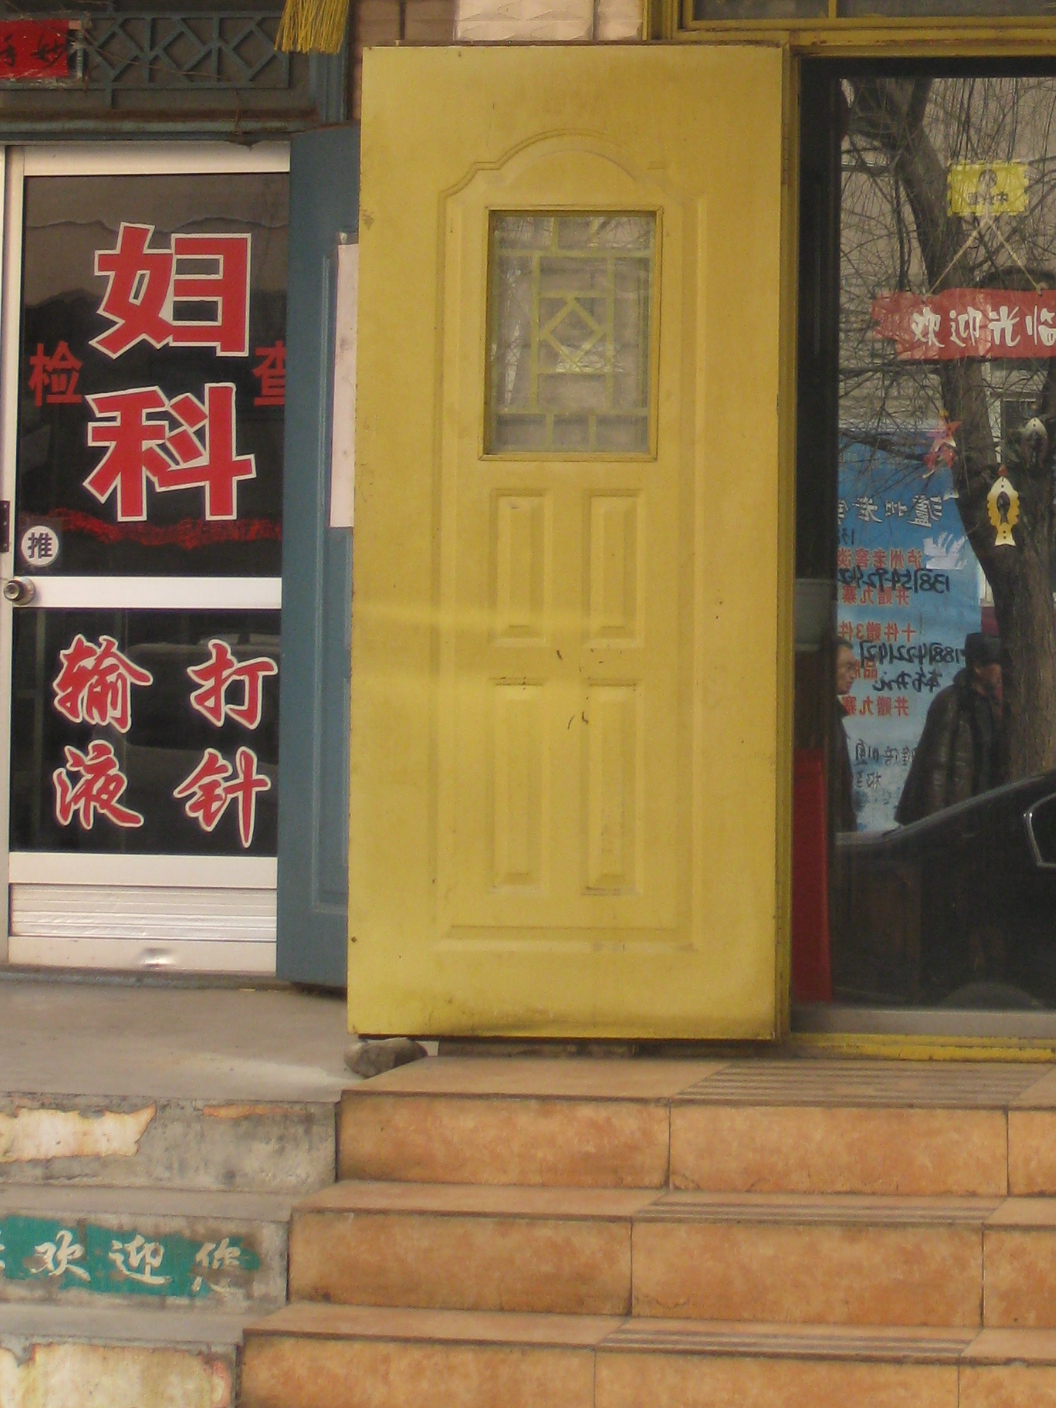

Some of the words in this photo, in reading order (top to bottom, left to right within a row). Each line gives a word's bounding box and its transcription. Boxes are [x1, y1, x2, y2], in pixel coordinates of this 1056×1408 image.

[83, 222, 257, 522] 妇科
[27, 531, 54, 560] 推
[52, 633, 154, 831] 输液
[173, 638, 279, 849] 打针
